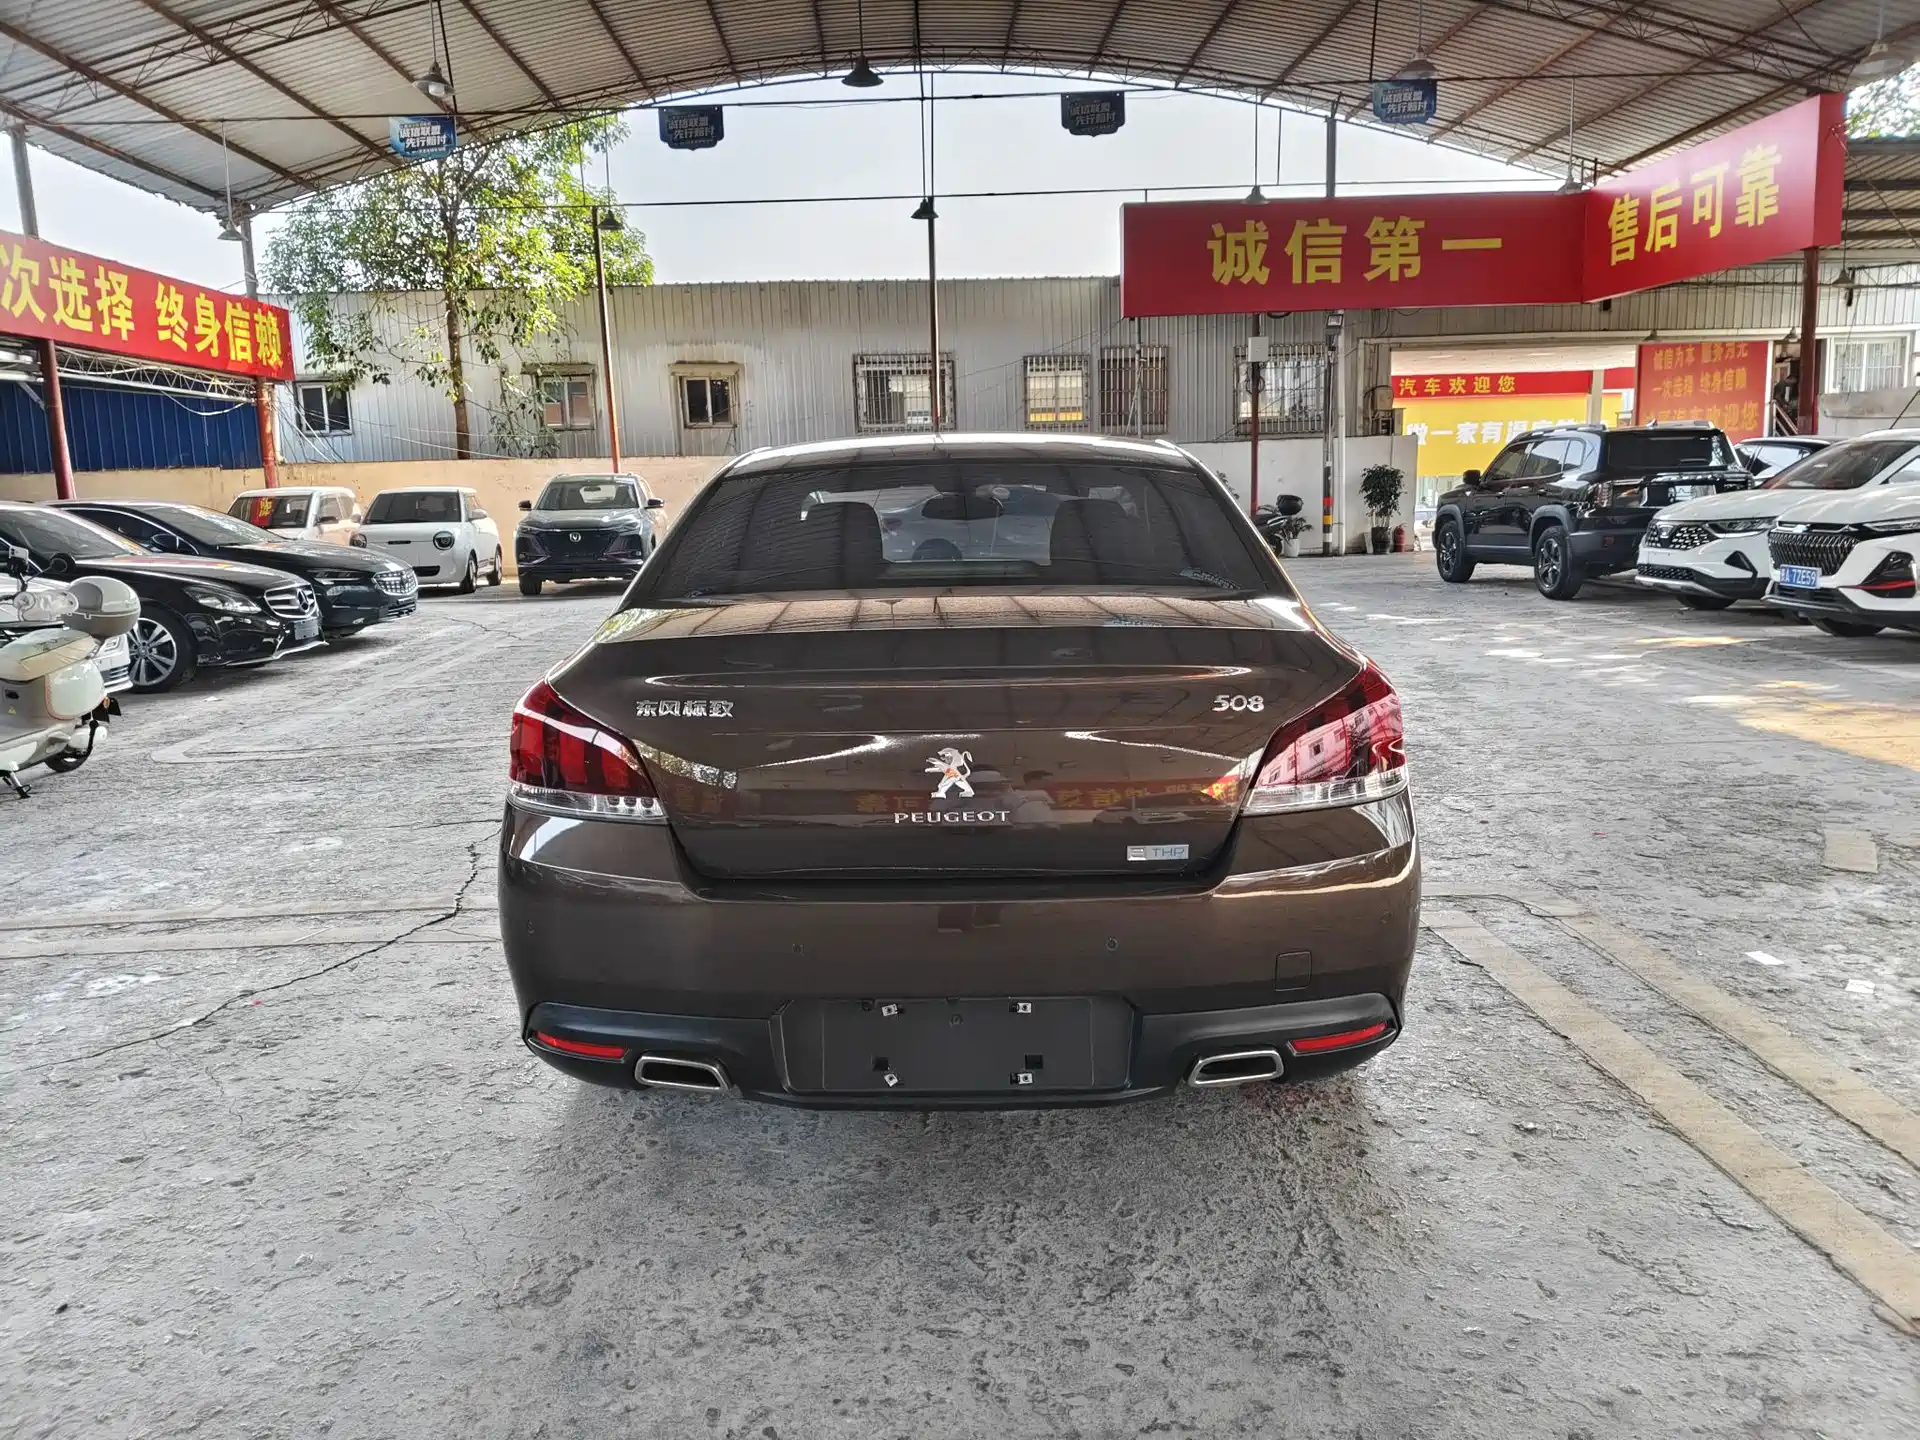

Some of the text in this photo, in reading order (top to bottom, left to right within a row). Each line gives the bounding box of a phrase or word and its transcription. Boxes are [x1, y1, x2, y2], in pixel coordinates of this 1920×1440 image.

[1608, 143, 1783, 266] 售后可靠
[1207, 215, 1502, 285] 诚信第一
[155, 281, 283, 369] 终身信赖
[1399, 375, 1515, 396] 汽车欢迎您
[636, 700, 734, 717] 东风标致
[1211, 694, 1264, 712] 508
[894, 810, 1010, 824] PEUGEOT
